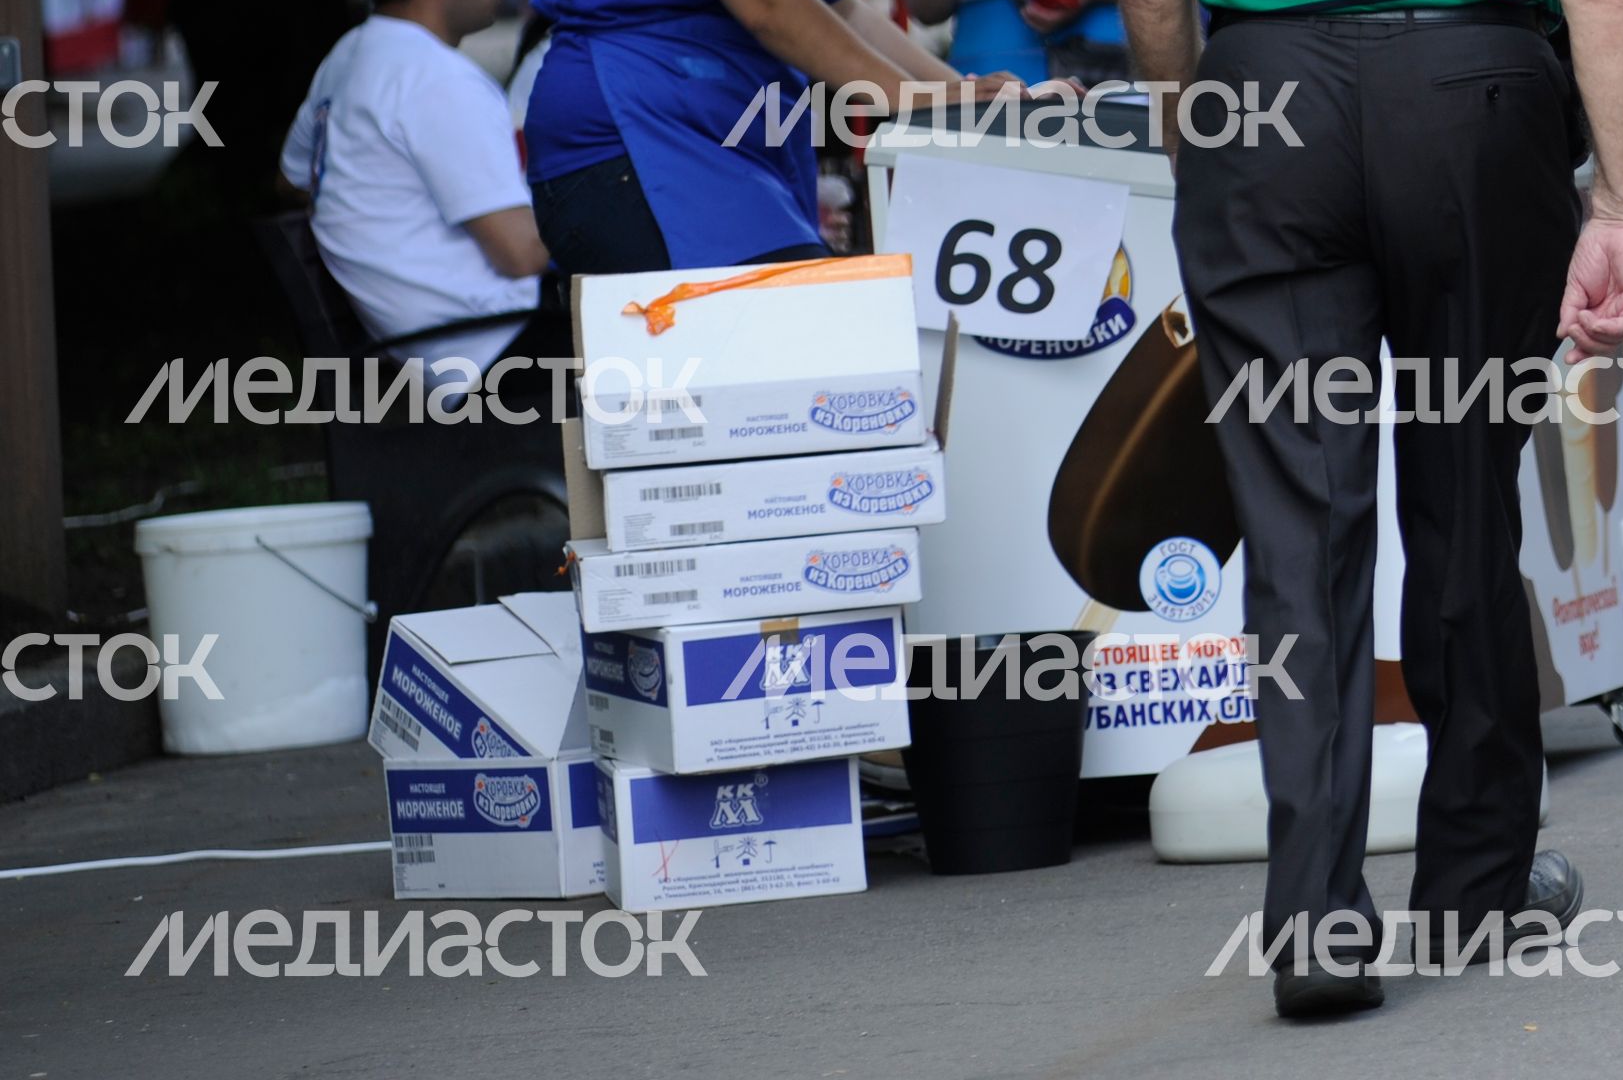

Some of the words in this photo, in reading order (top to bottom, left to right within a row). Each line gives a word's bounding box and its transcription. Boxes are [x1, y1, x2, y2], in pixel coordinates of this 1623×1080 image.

[935, 218, 1063, 315] 68
[827, 389, 897, 412] КОРОВКА
[729, 421, 809, 440] МОРОЖЕНОЕ
[846, 470, 916, 492] КОРОВКА
[747, 502, 827, 520] МОРОЖЕНОЕ
[1158, 540, 1197, 558] ГОСТ
[820, 549, 891, 571] КОРОВКА
[722, 580, 803, 599] МОРОЖЕНОЕ
[391, 663, 463, 742] МОРОЖЕНОЕ
[484, 779, 528, 799] КОРОВКА
[396, 800, 465, 819] МОРОЖЕНОЕ
